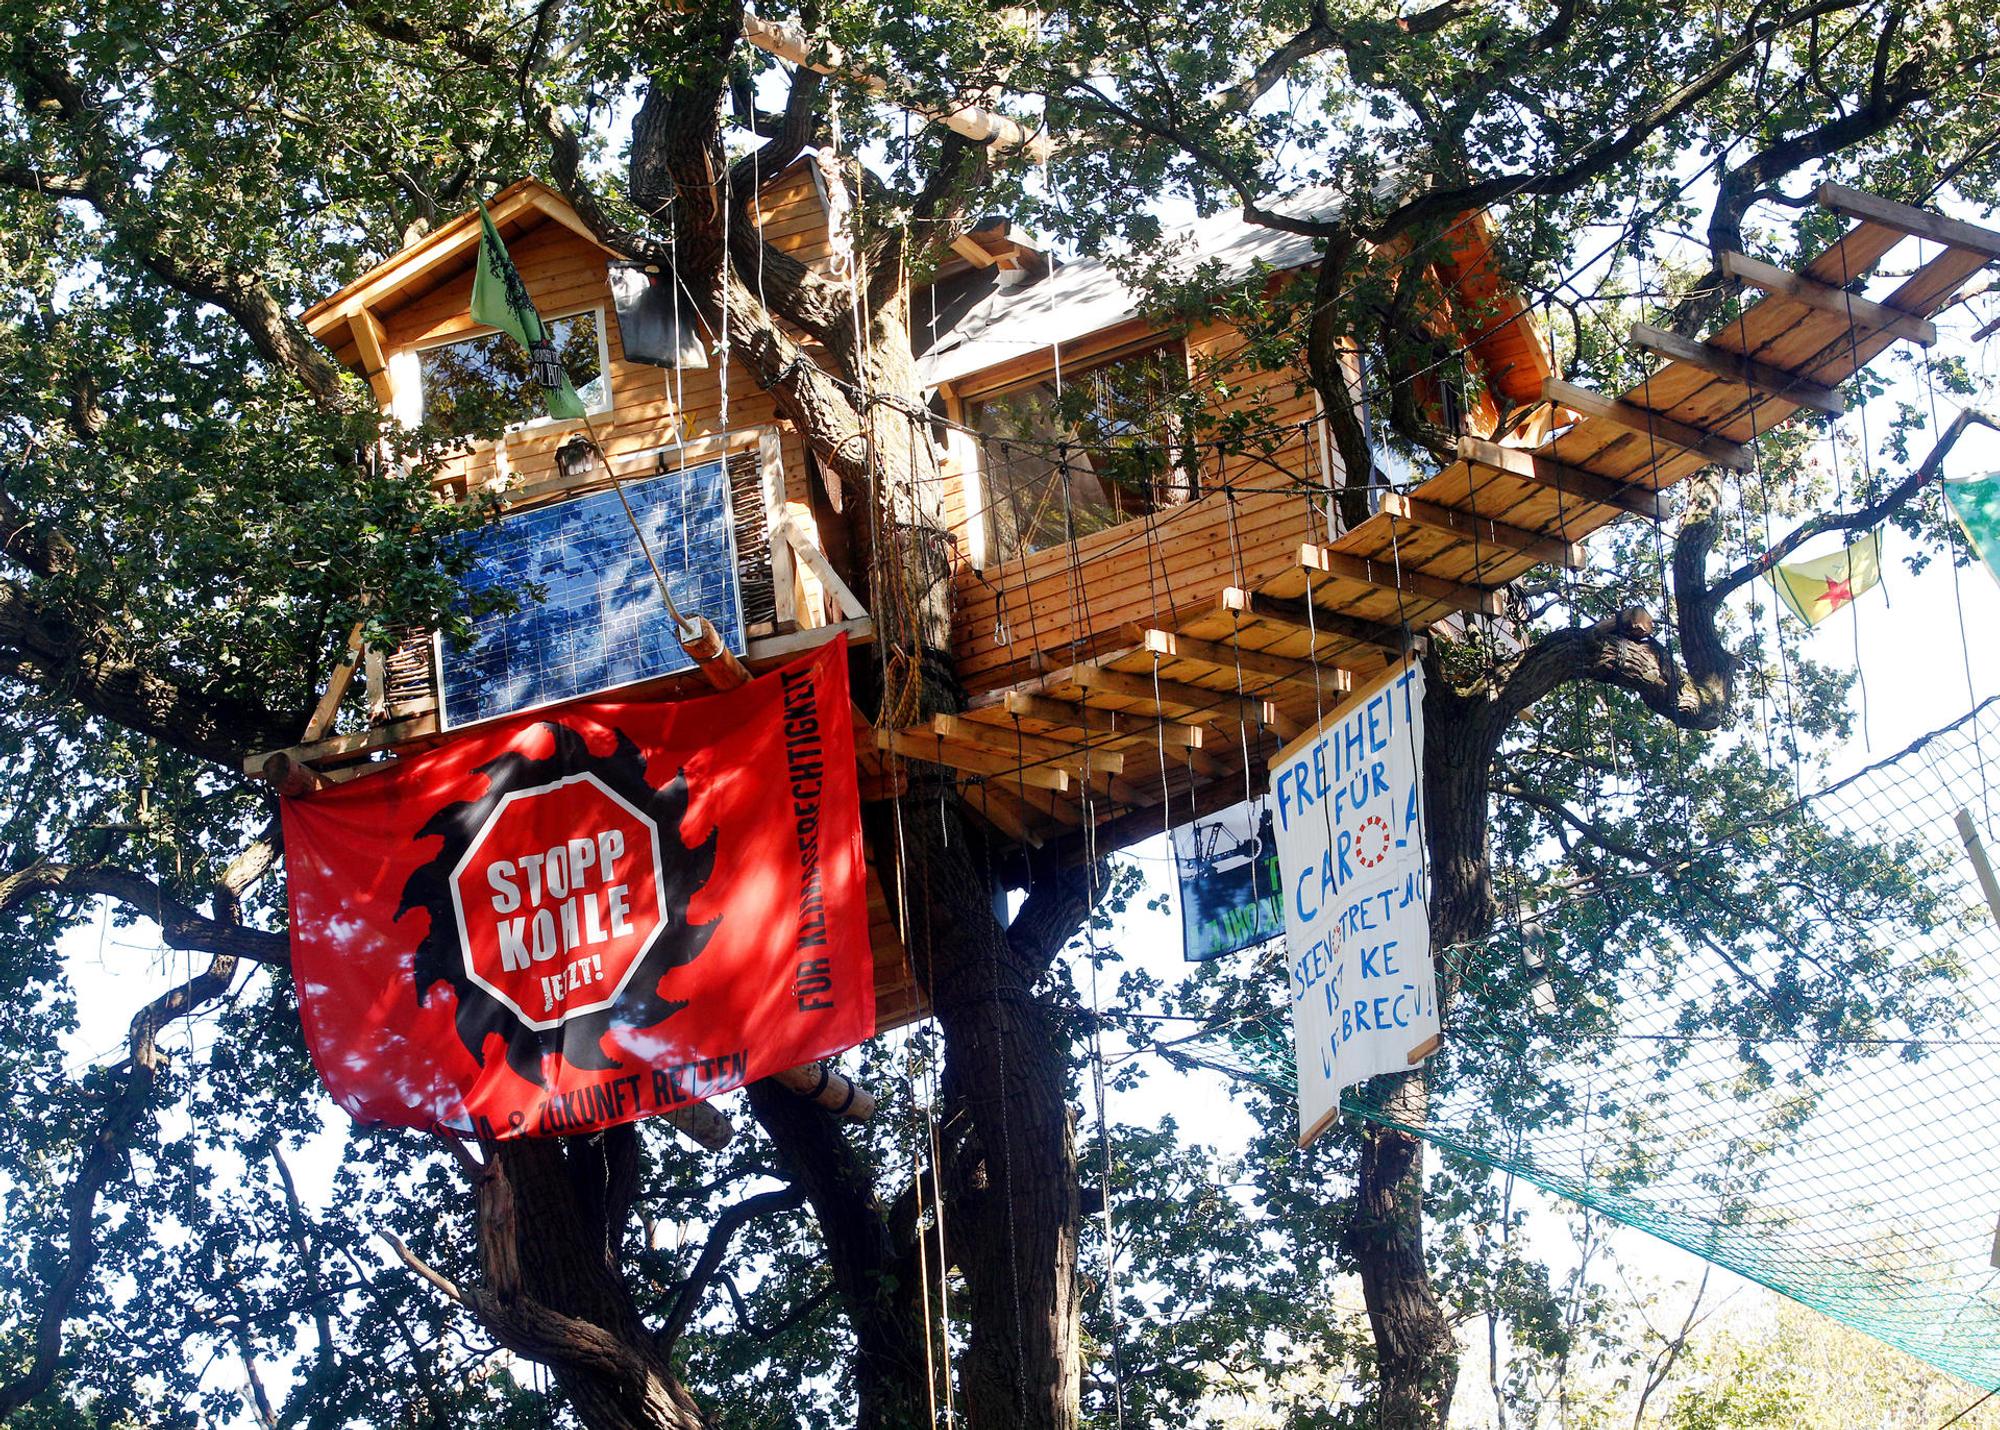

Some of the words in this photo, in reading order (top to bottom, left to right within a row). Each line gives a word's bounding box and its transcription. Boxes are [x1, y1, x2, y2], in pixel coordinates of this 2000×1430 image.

[1276, 669, 1416, 832] FREIHEIT
[1335, 760, 1390, 826] FÜR
[487, 829, 625, 914] STOPP
[496, 884, 634, 972] KOHLE
[792, 957, 834, 1012] FÜR
[538, 1074, 640, 1135] ZUKUNFT
[652, 1048, 748, 1107] RETTEN
